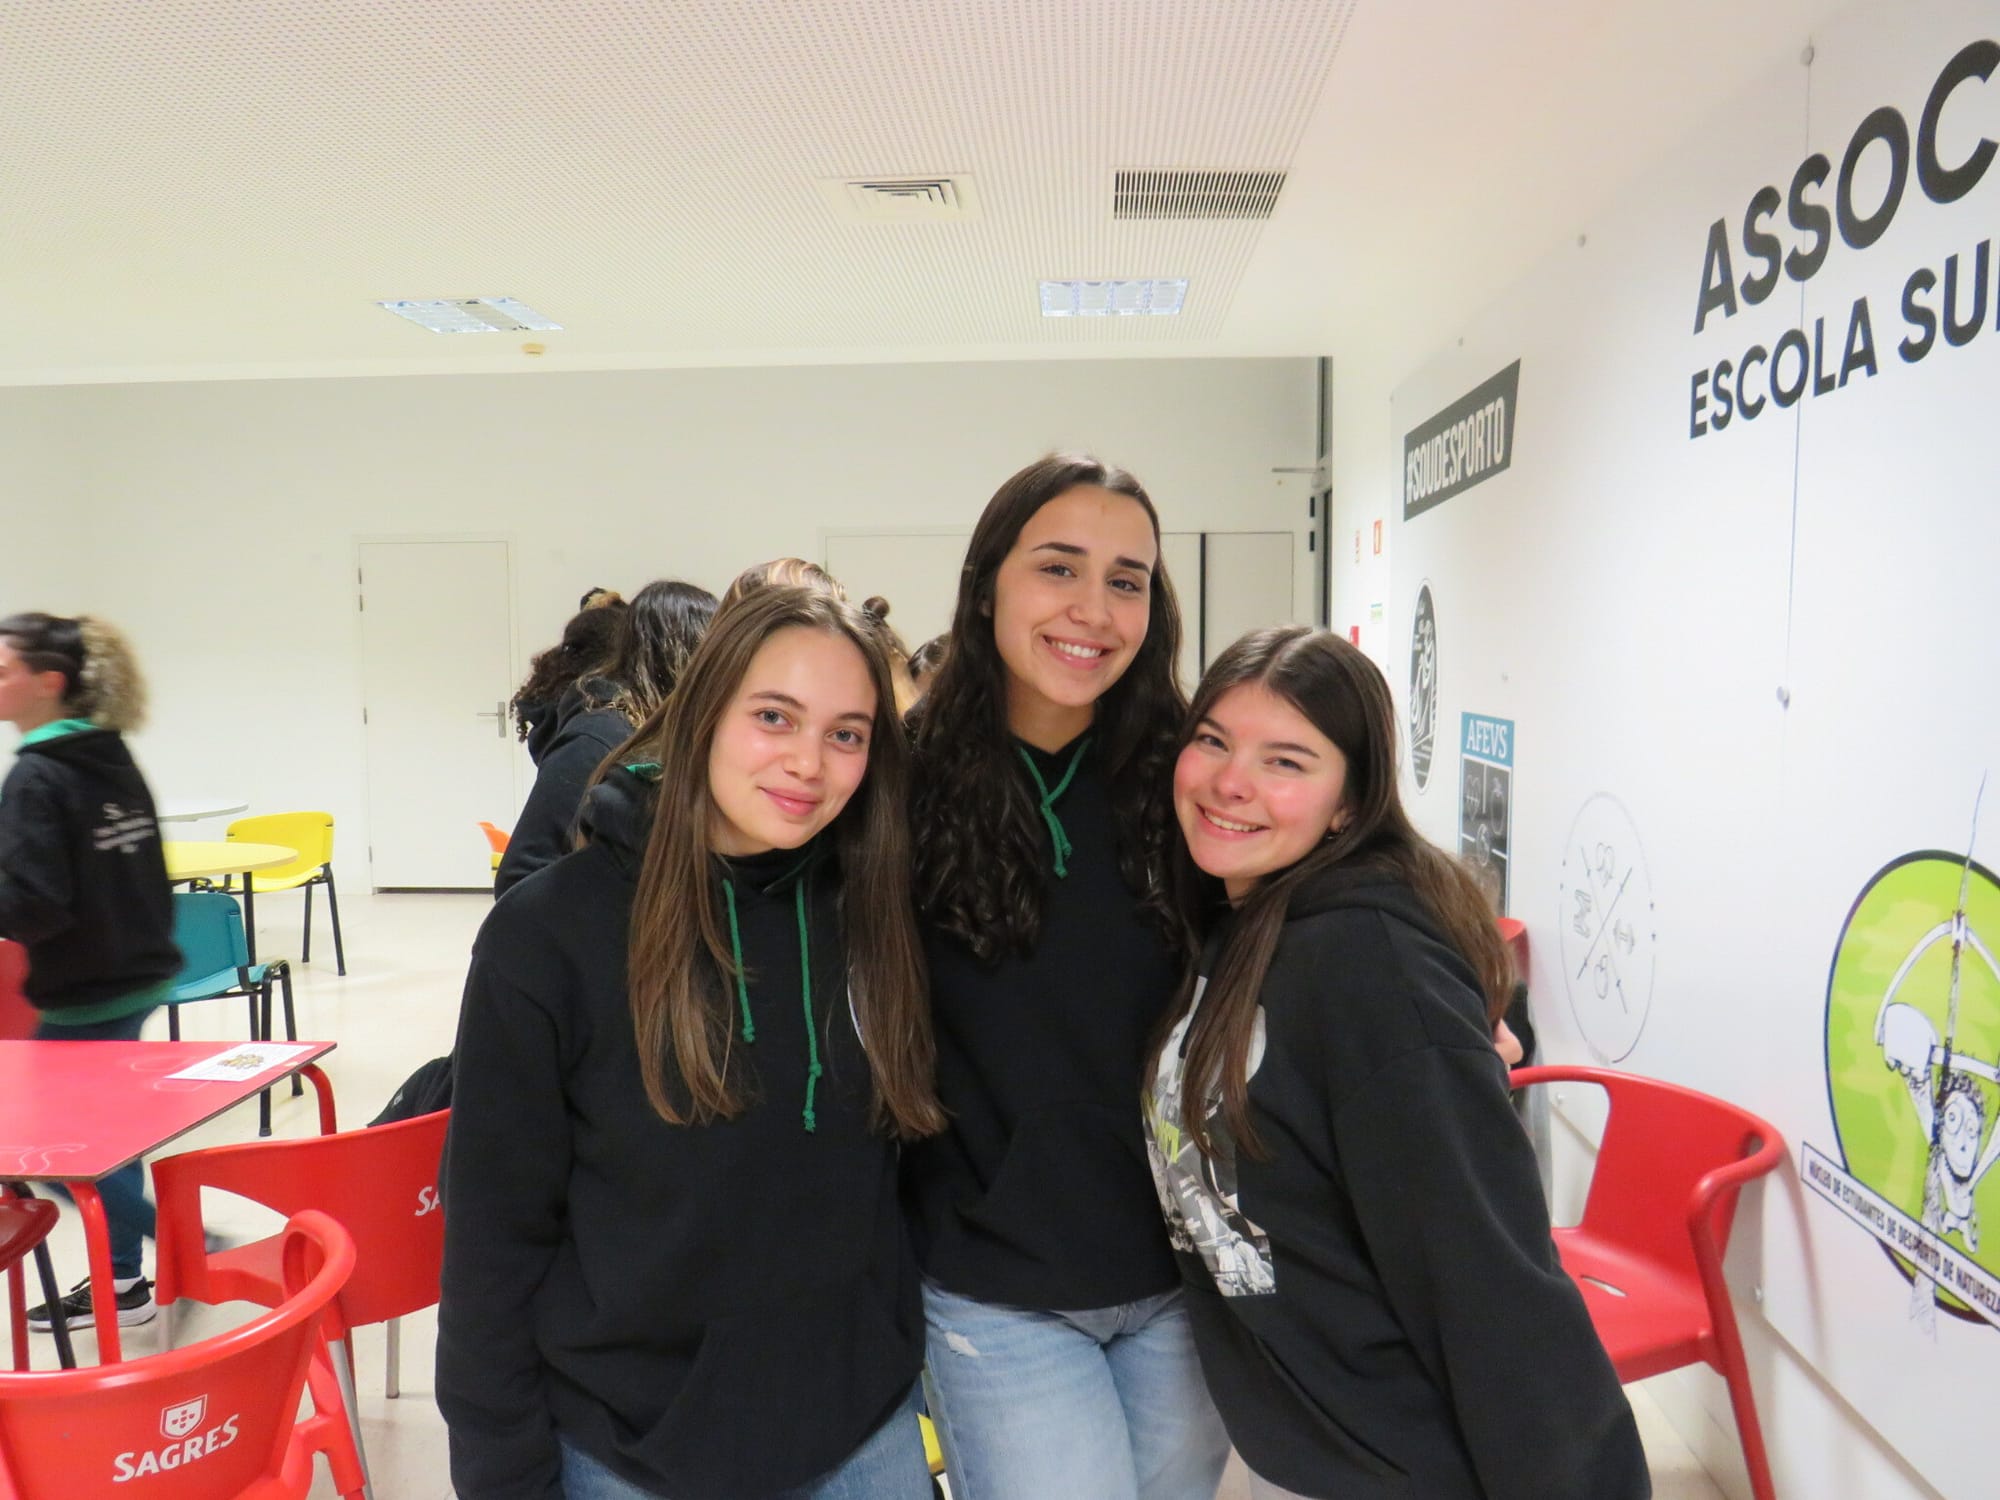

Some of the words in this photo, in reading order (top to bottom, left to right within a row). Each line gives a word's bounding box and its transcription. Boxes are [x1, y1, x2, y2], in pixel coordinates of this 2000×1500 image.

[1693, 39, 2000, 335] ASSOC
[1690, 296, 1878, 439] ESCOLA
[1898, 238, 2000, 363] SU
[1406, 396, 1505, 505] #SOUDESPORTO
[1466, 719, 1508, 760] AFEVS
[1842, 1184, 1885, 1231] ESTUDANTES
[1887, 1216, 1897, 1239] DE
[1943, 1257, 1954, 1281] DE
[112, 1413, 239, 1482] SAGRES
